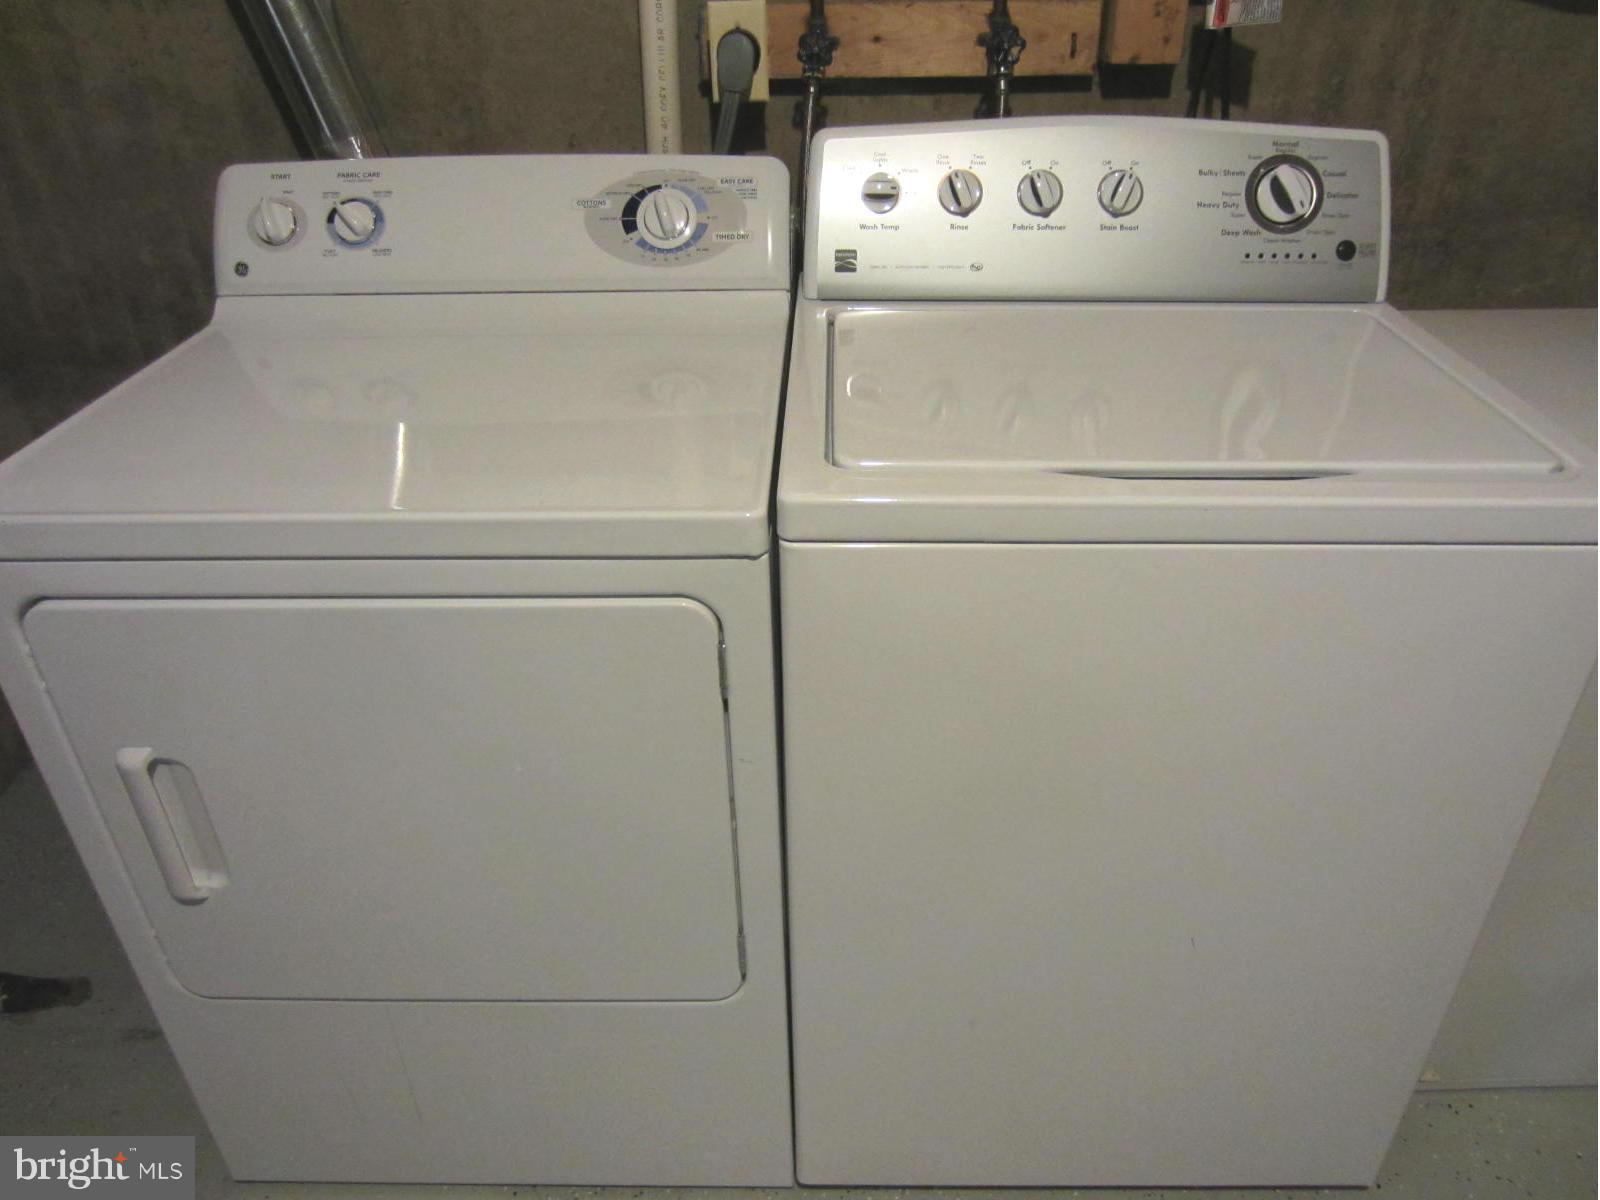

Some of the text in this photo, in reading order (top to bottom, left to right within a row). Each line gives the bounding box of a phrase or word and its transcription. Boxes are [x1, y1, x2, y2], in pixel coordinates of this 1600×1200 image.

[1196, 201, 1240, 209] Heavy Duty
[1221, 229, 1240, 237] Deep
